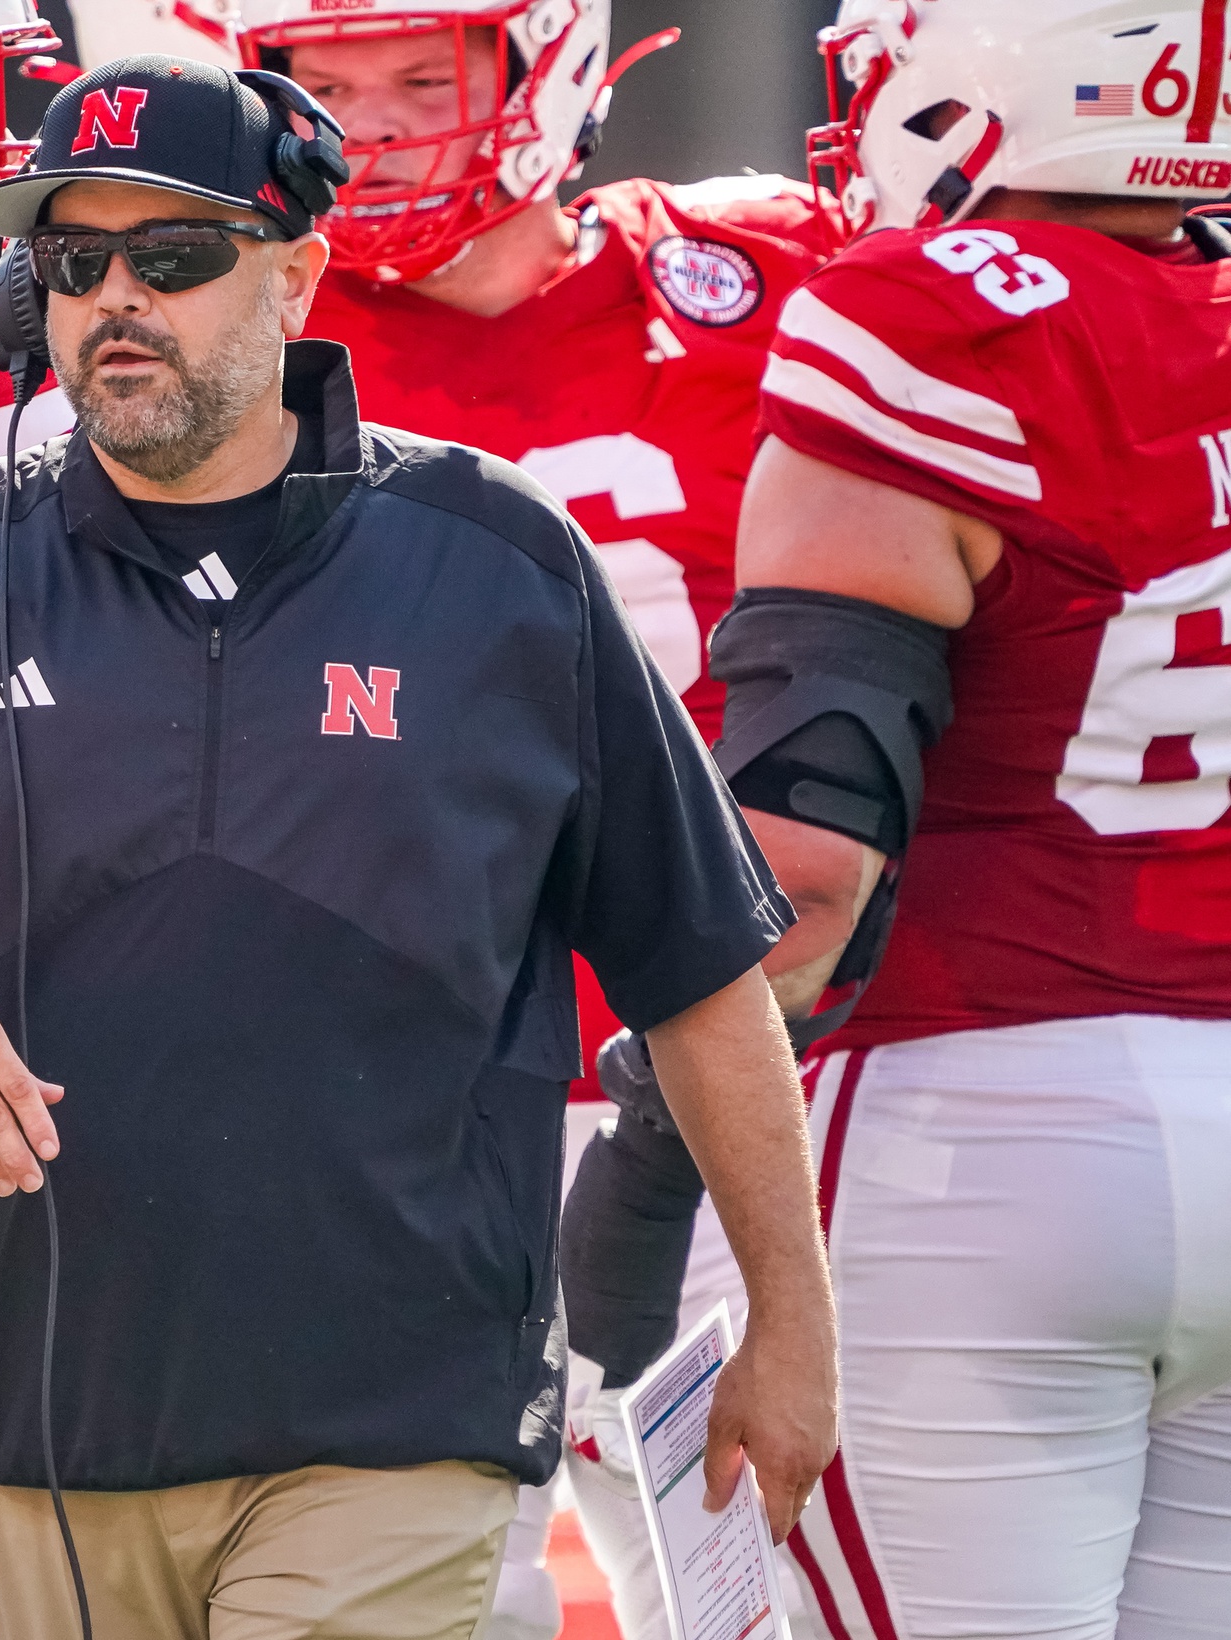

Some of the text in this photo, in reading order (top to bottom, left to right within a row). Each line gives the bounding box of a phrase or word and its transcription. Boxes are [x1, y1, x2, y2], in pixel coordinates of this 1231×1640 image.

[71, 86, 148, 157] N
[922, 229, 1070, 317] 63
[321, 662, 401, 740] N
